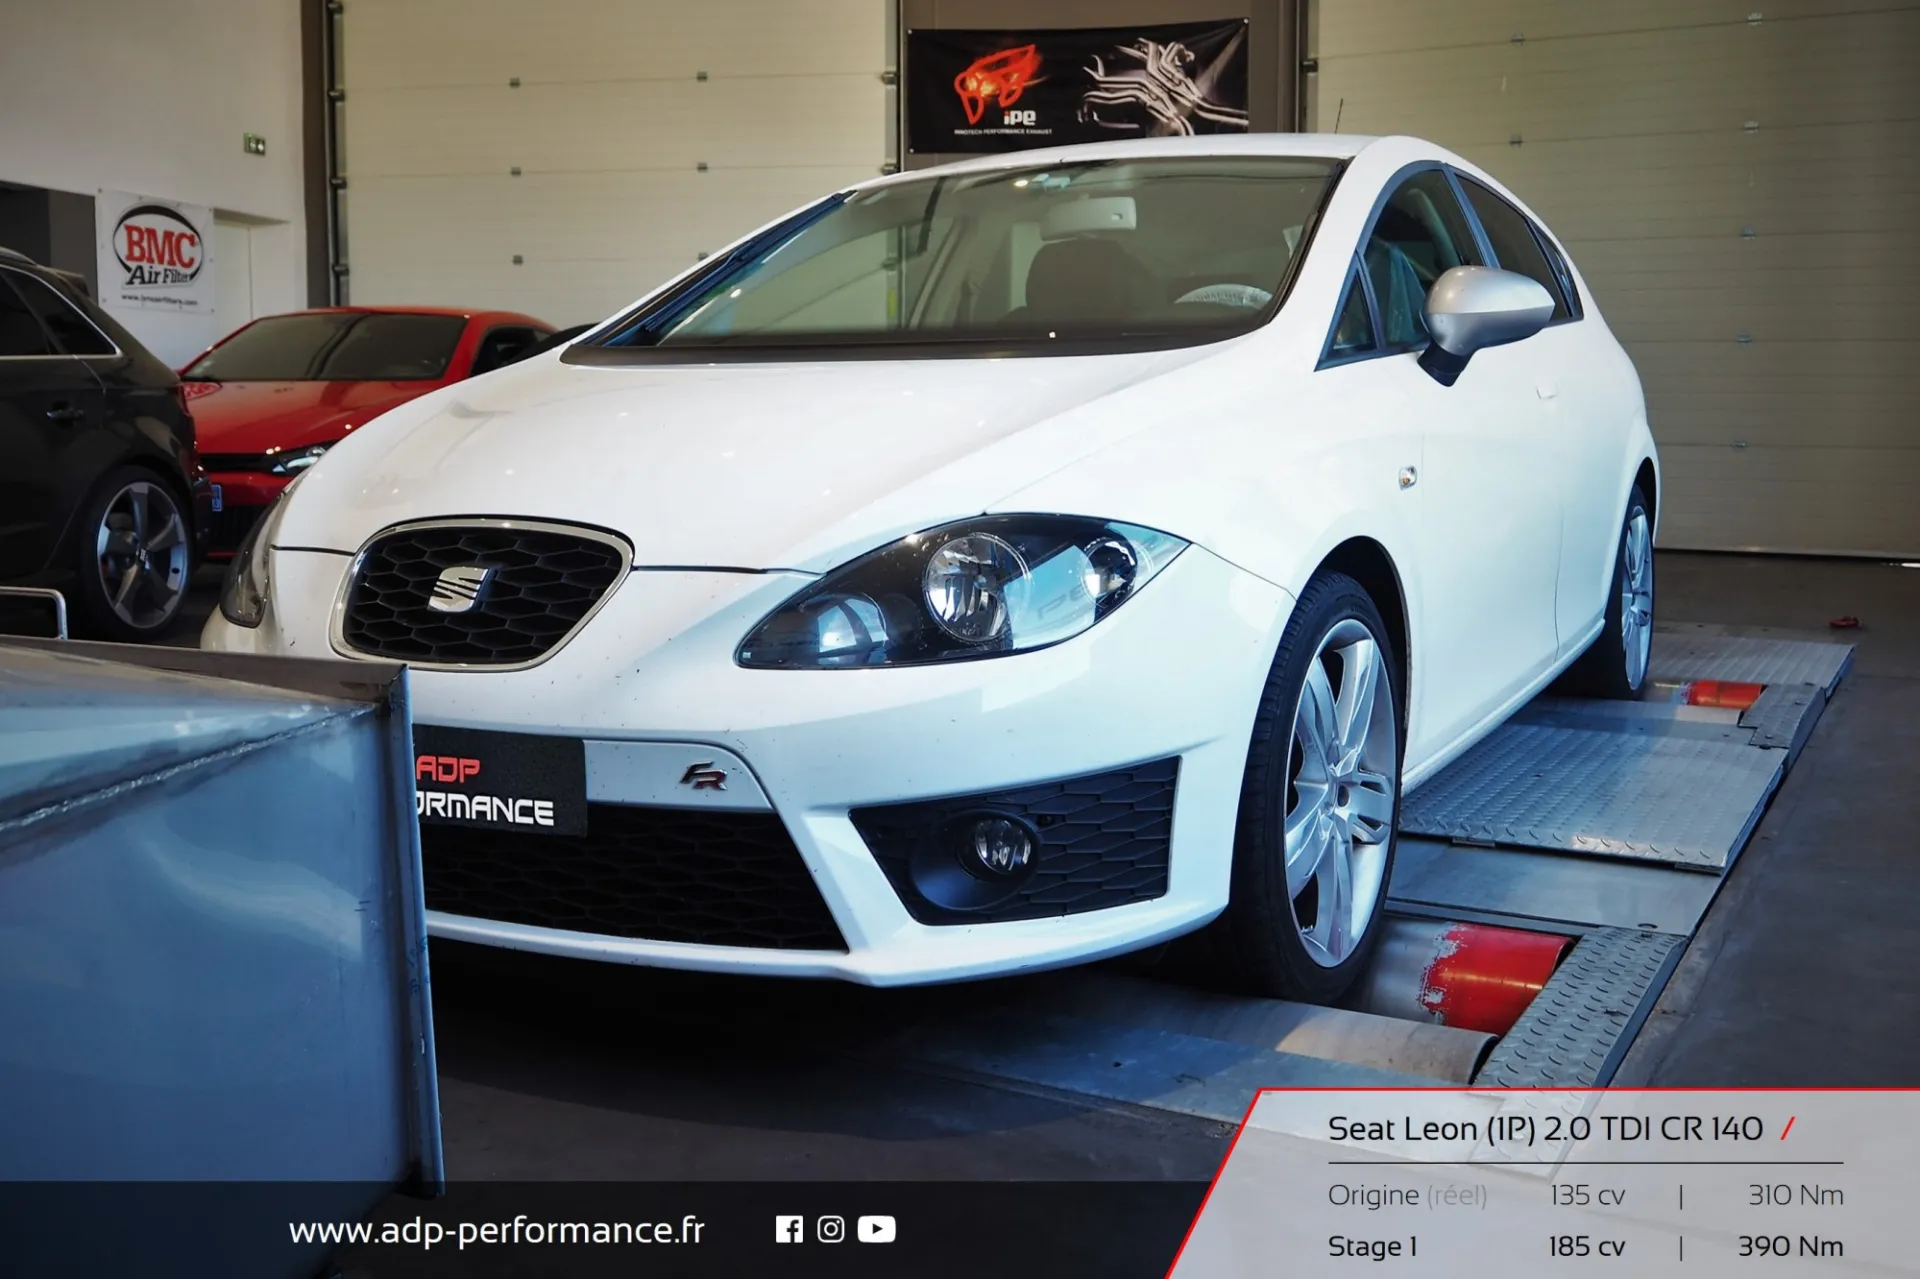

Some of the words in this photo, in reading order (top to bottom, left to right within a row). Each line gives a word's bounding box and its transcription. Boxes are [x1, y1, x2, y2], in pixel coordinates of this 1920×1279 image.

[124, 224, 196, 269] BMC
[126, 264, 160, 285] Air
[416, 754, 481, 784] ADP
[679, 760, 728, 791] FR
